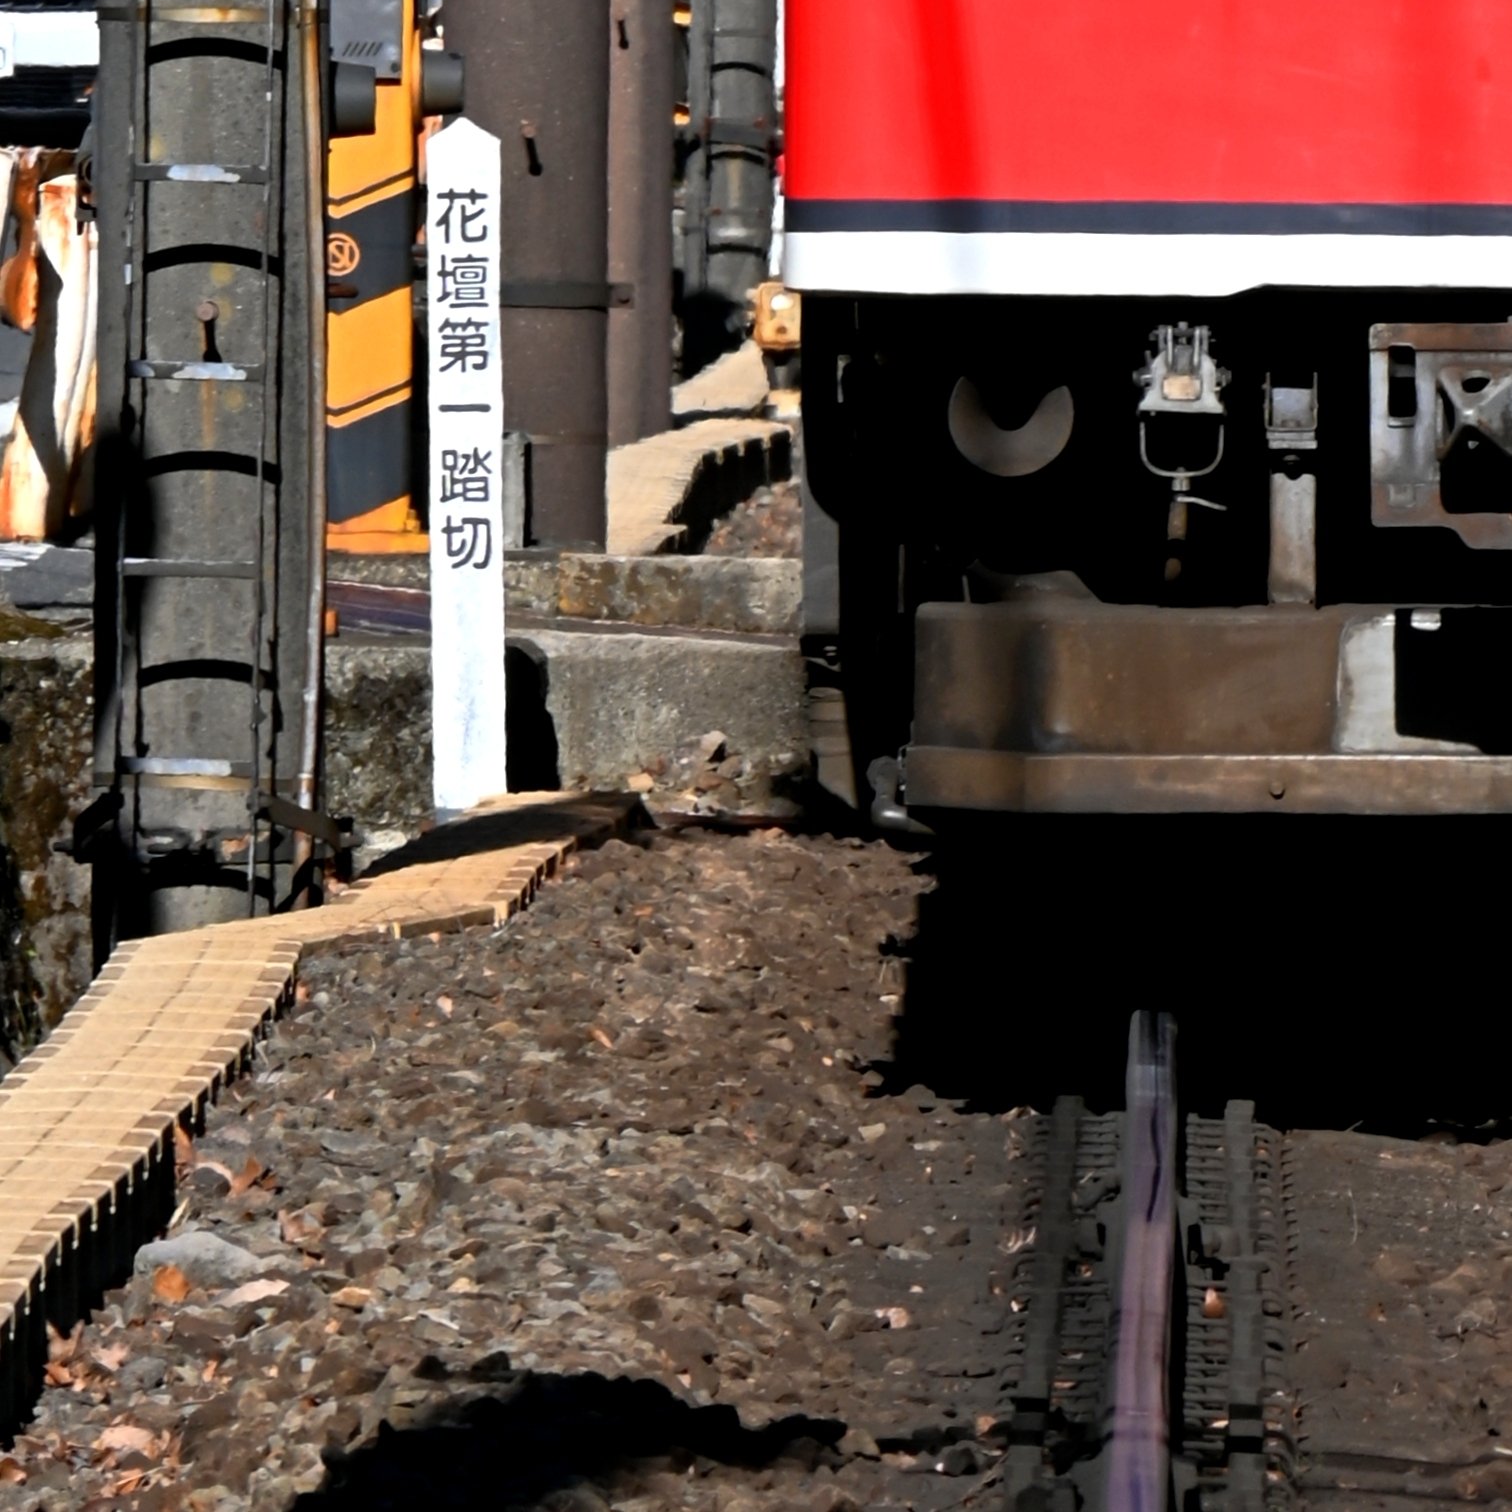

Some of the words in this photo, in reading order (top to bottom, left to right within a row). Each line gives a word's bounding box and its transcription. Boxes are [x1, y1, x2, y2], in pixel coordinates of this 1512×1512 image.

[436, 188, 493, 569] 花壇第一踏切
